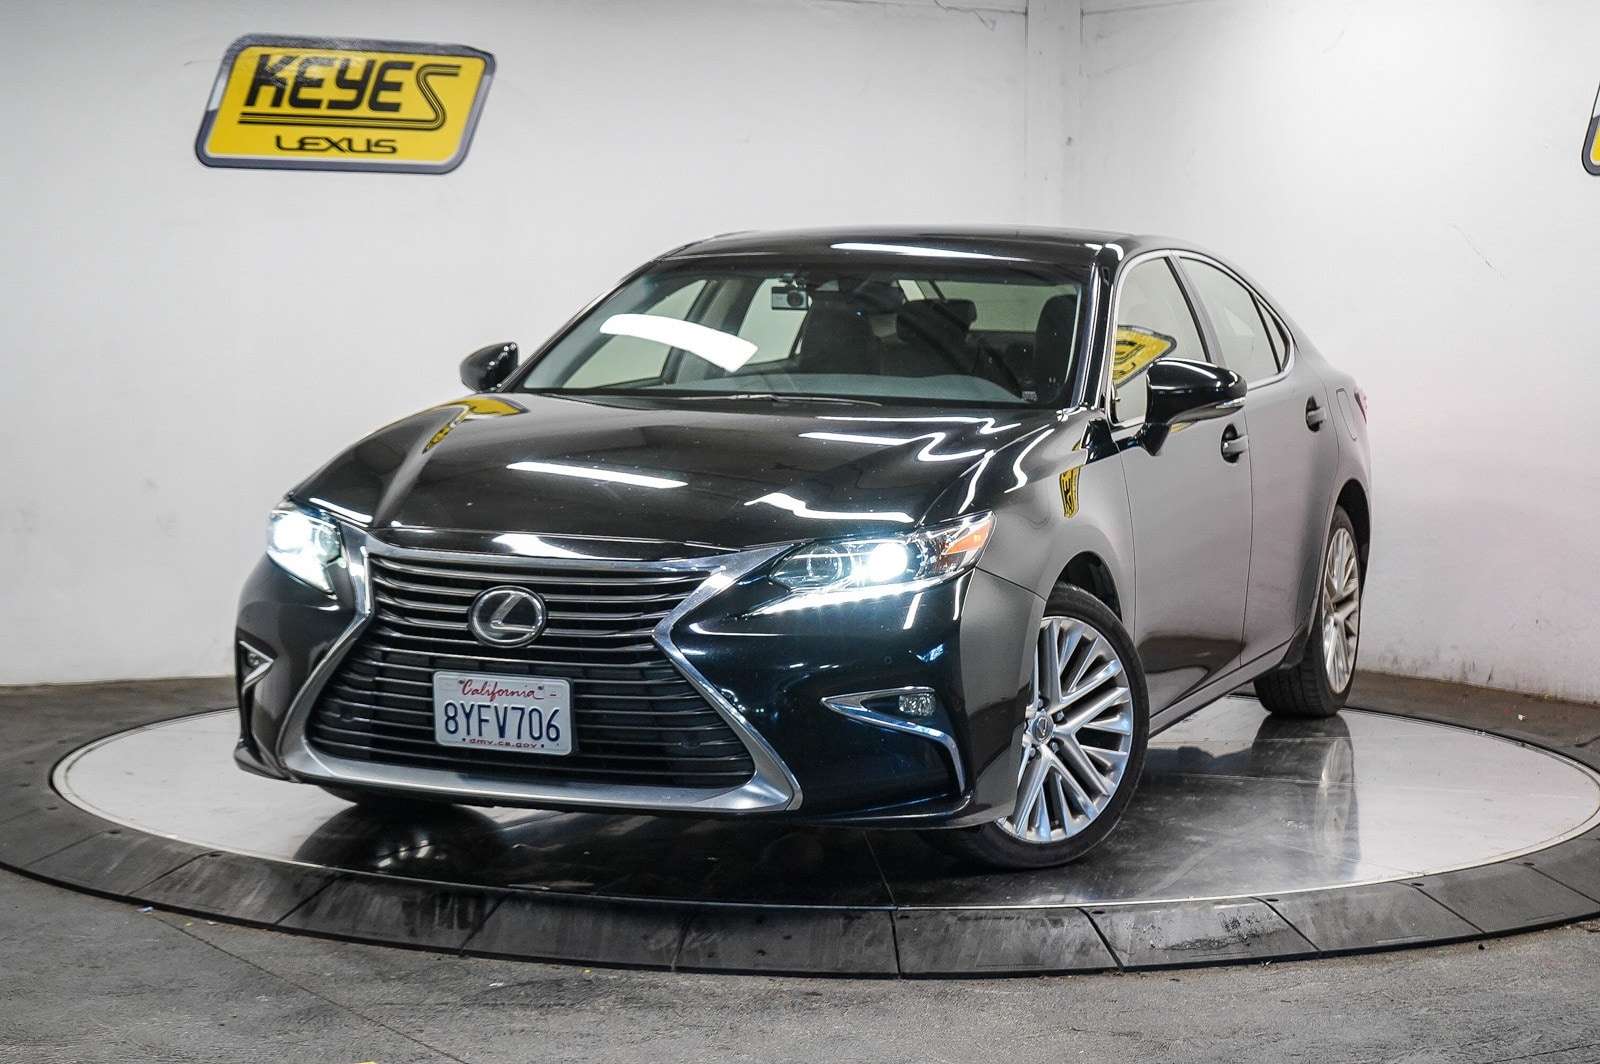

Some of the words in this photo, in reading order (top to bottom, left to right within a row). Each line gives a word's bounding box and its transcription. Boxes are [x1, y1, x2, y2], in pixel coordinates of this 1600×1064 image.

[239, 53, 462, 131] KEYES
[275, 135, 399, 154] LEXUS
[461, 679, 545, 702] California
[444, 701, 561, 742] 8YFV706
[468, 737, 538, 749] dmv.ca.gov
